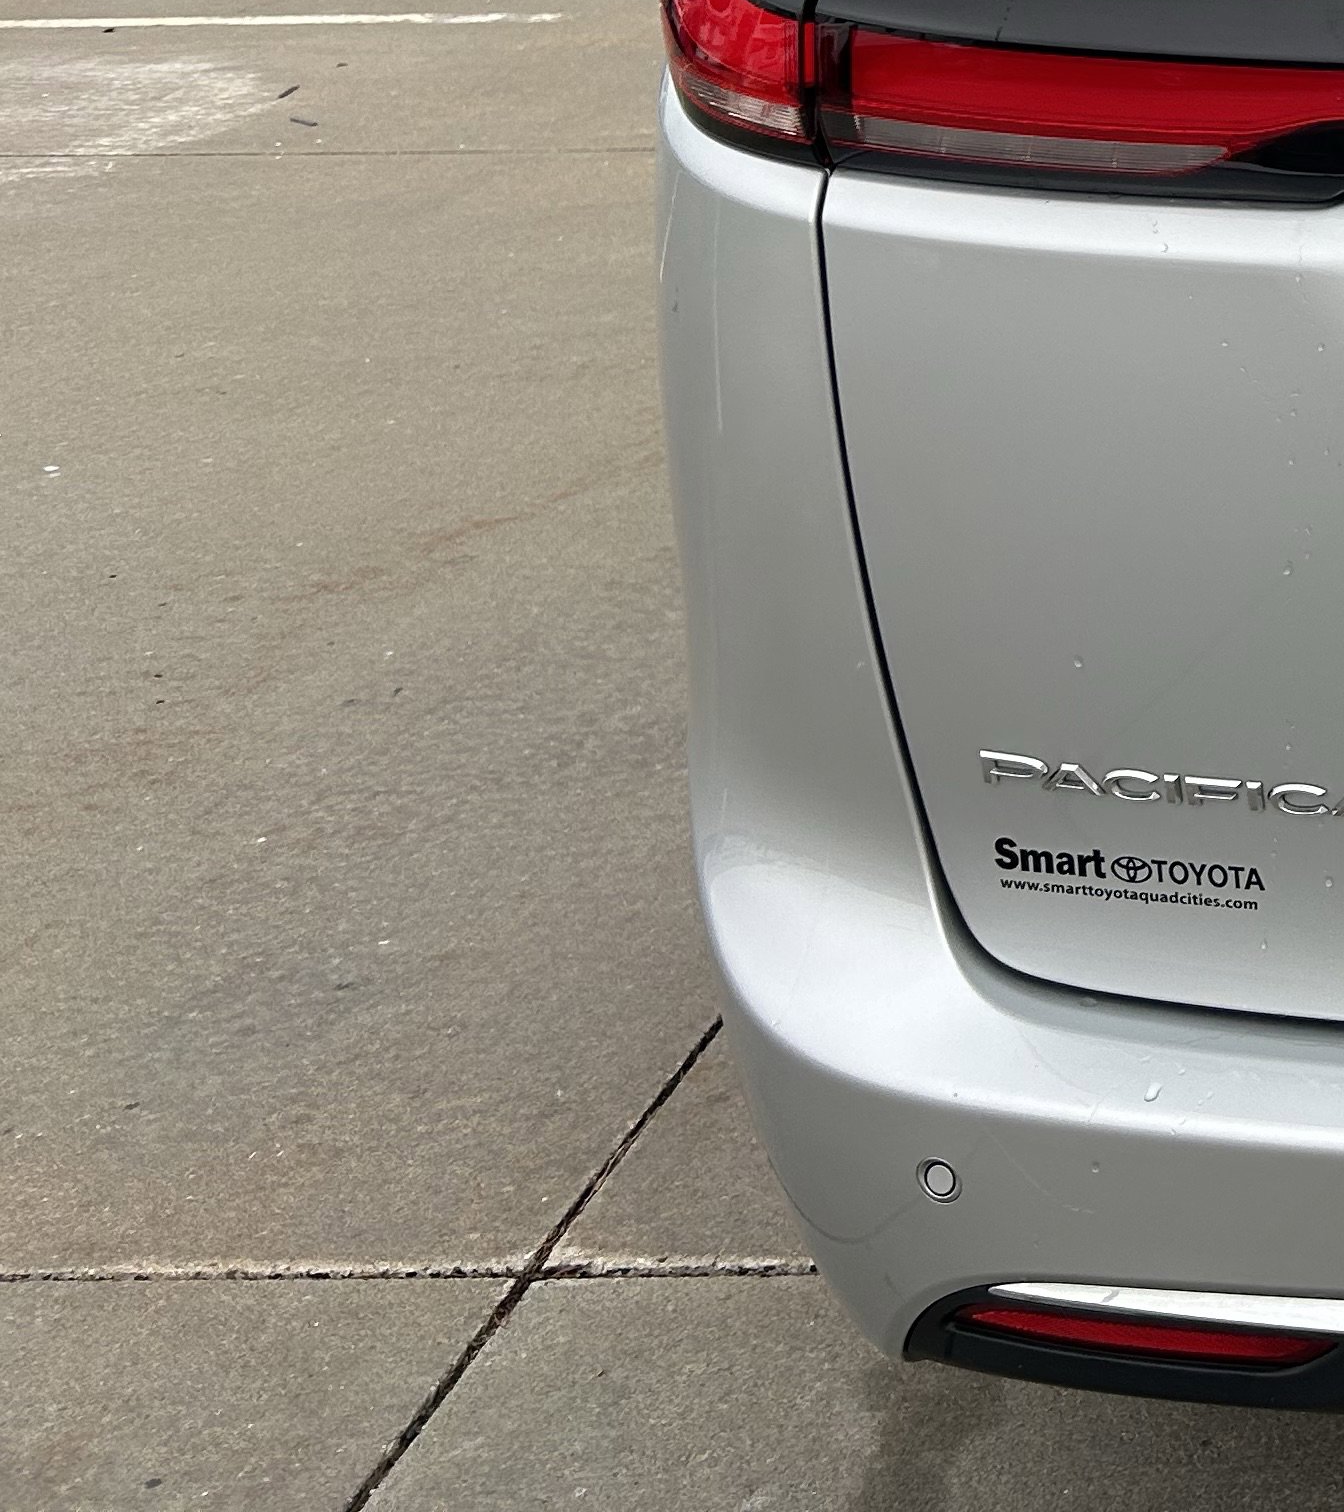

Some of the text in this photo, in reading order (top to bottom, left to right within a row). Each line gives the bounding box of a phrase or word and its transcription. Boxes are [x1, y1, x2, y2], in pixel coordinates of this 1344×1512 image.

[994, 837, 1266, 892] Smart TOYOTA
[999, 877, 1259, 911] www.smarttoyotaquadcities.com
